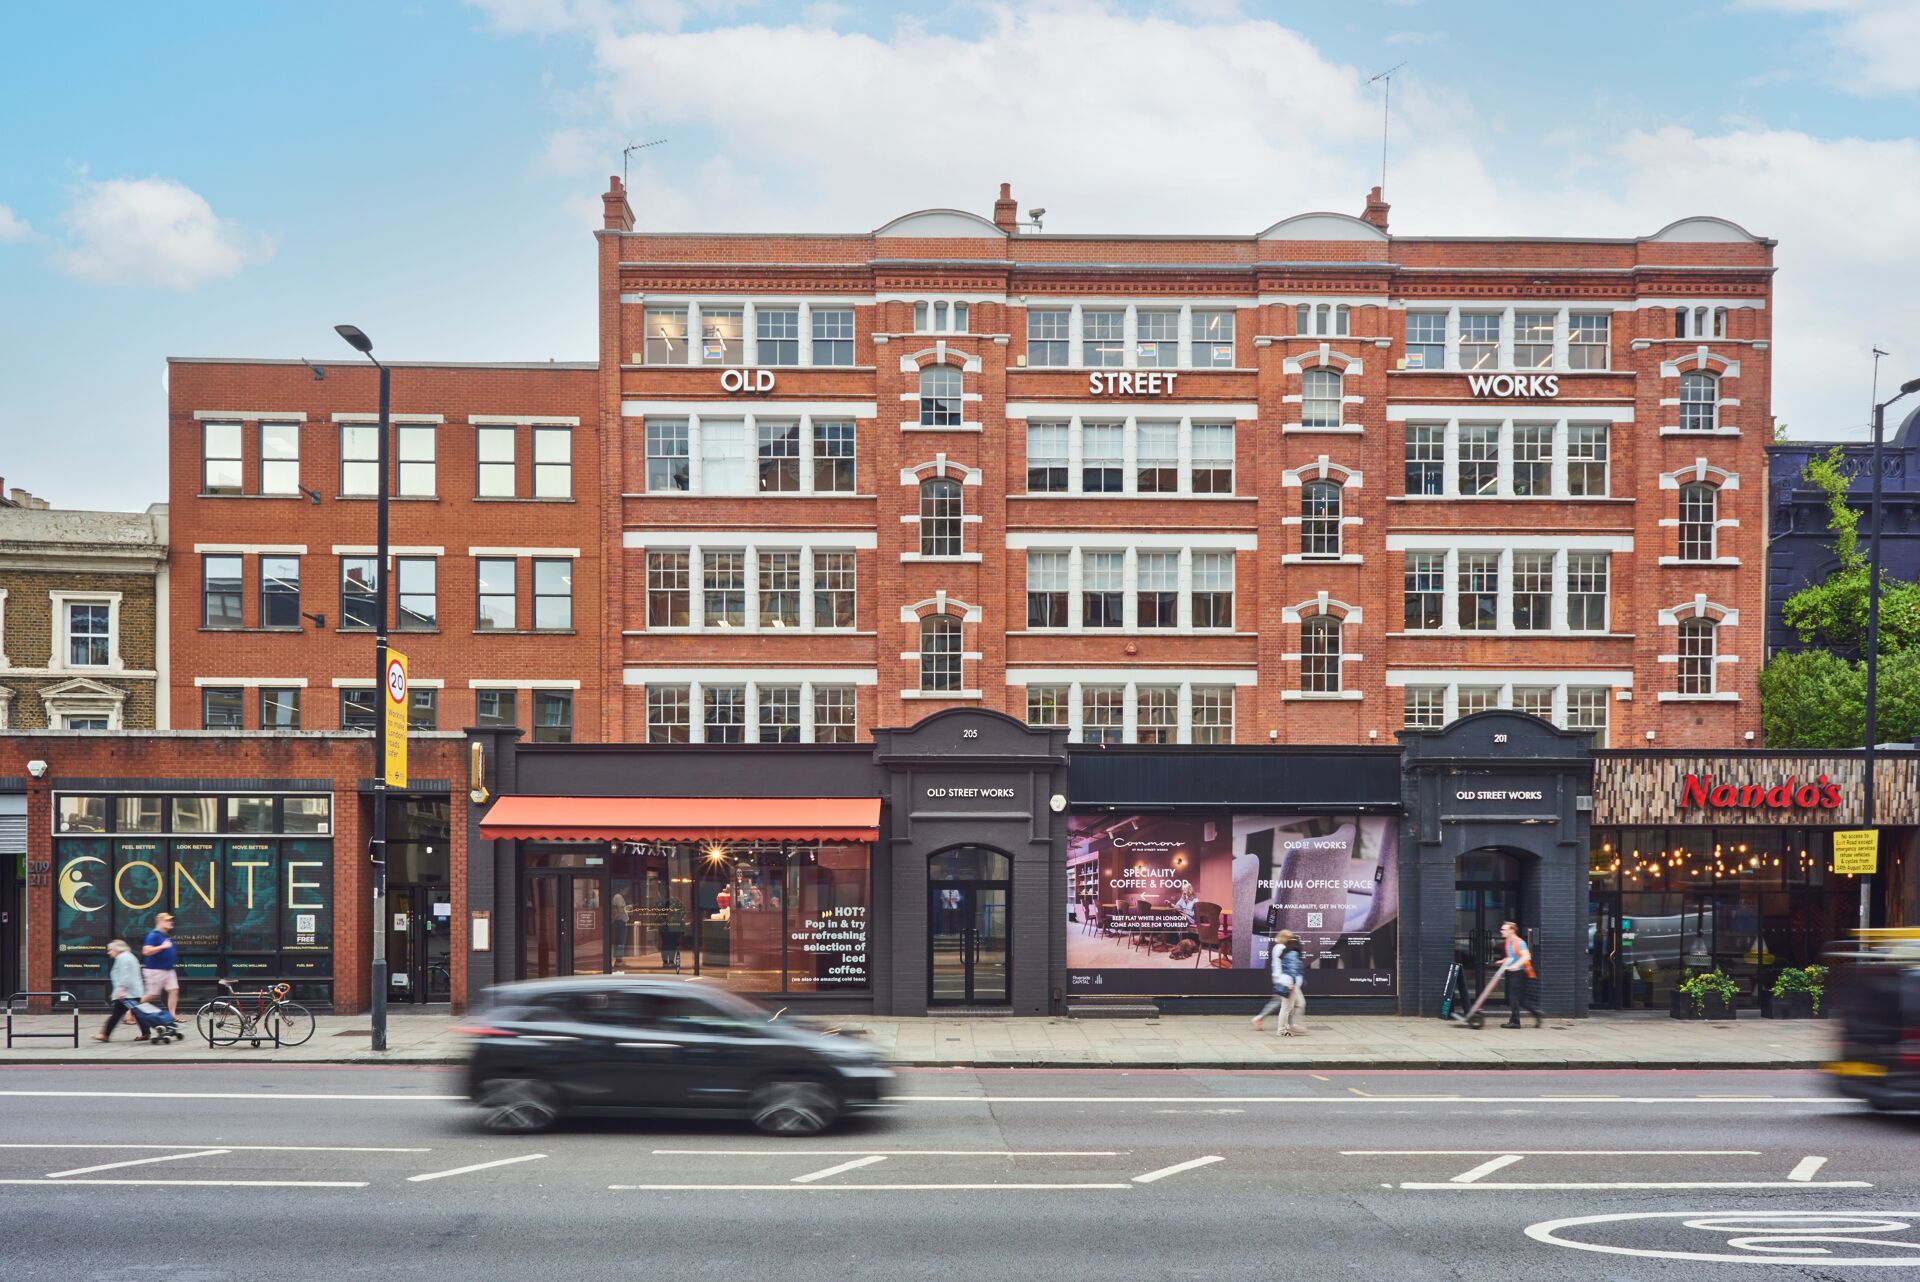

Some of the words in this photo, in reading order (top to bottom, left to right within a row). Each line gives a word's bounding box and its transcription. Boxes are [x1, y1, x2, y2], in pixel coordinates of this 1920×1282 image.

[720, 369, 775, 392] OLD
[1089, 372, 1177, 394] STREET
[1468, 375, 1559, 397] WORKS
[391, 672, 403, 690] 20
[963, 729, 978, 738] 205
[1494, 734, 1508, 743] 201
[927, 788, 946, 797] OLD
[948, 788, 978, 797] STREET
[980, 788, 1014, 797] WORKS
[1456, 791, 1475, 800] OLD
[1477, 791, 1506, 800] STREET
[1508, 791, 1542, 800] WORKS
[1679, 773, 1841, 809] Nando's
[1113, 837, 1186, 848] Commons
[1284, 841, 1302, 849] OLD
[1314, 841, 1347, 849] WORKS
[28, 860, 50, 872] 209
[1123, 868, 1176, 878] SPECIALITY
[31, 873, 48, 886] 211
[1110, 879, 1146, 888] COFFEE
[1149, 879, 1157, 888] &
[1160, 879, 1188, 888] FOOD
[1258, 880, 1303, 889] PREMIUM
[1306, 880, 1340, 889] OFFICE
[1343, 880, 1373, 889] SPACE
[835, 907, 865, 916] HOT?
[805, 920, 825, 929] Pop
[828, 920, 837, 928] in
[840, 920, 848, 928] &
[851, 920, 865, 929] try
[812, 931, 866, 941] refreshing
[803, 943, 852, 951] selection
[854, 942, 866, 951] of
[828, 966, 865, 974] coffee.
